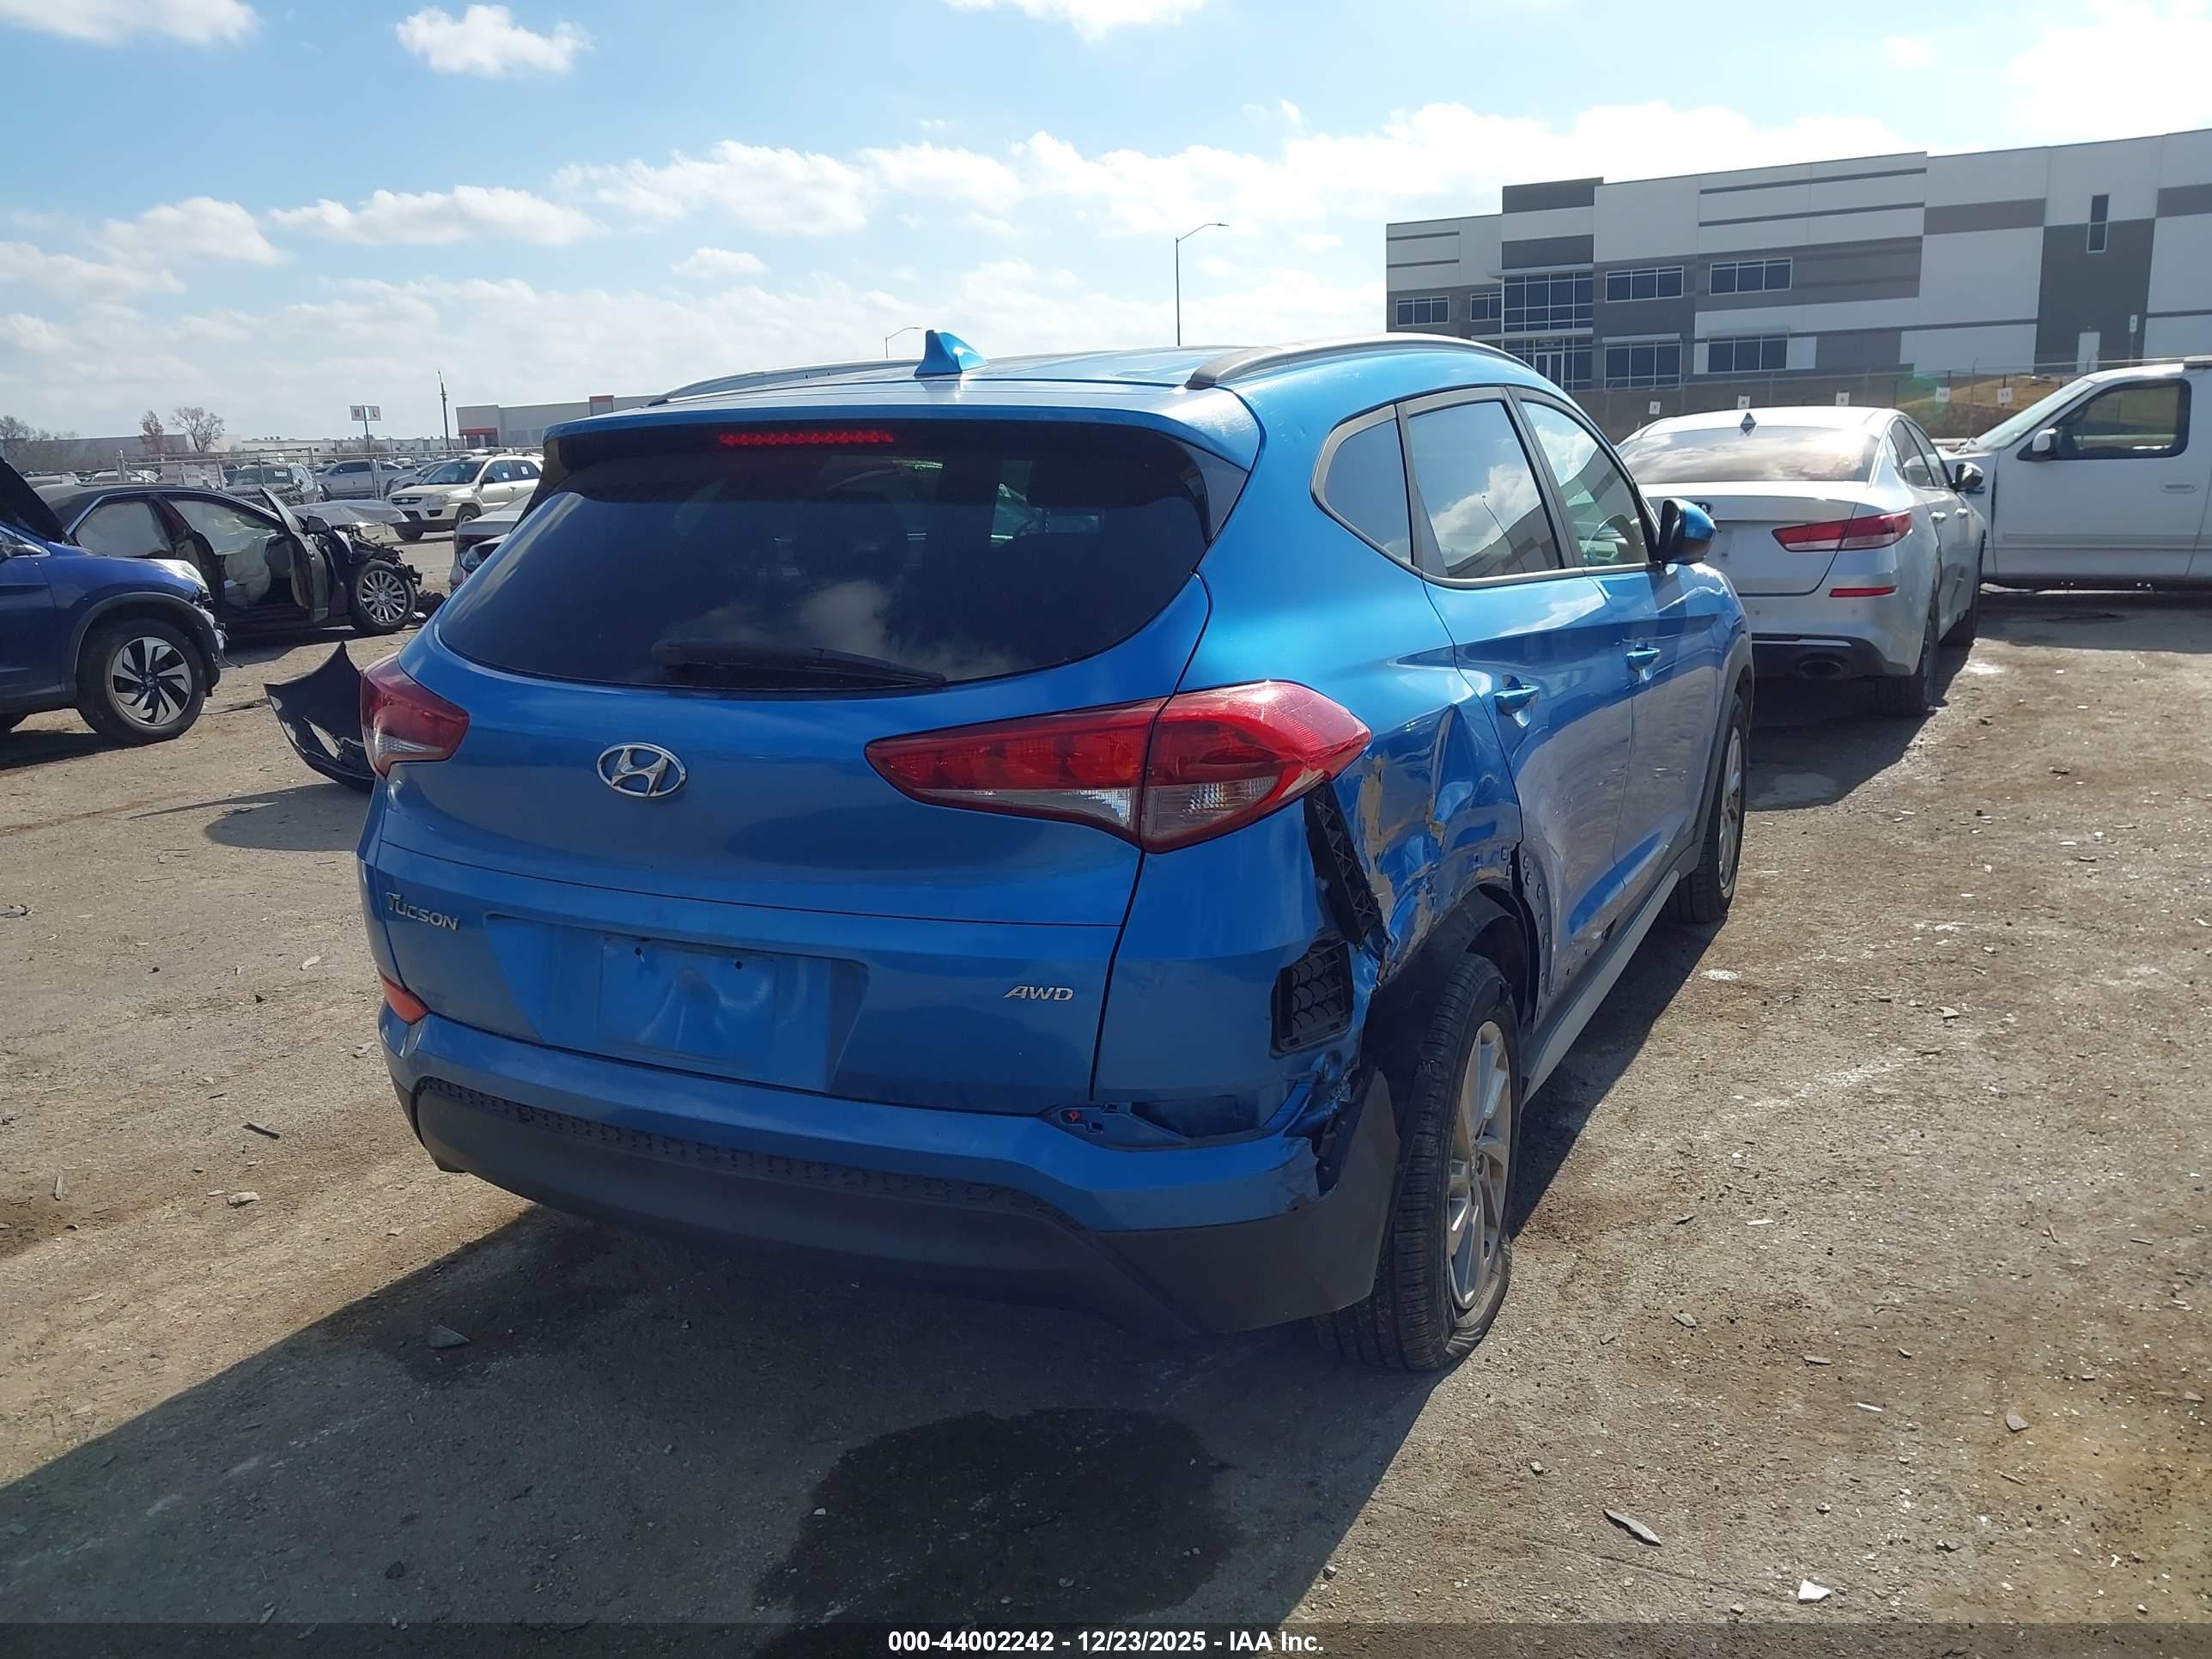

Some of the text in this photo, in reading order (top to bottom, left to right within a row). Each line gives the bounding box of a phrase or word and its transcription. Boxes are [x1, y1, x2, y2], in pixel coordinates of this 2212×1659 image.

[372, 409, 378, 417] L
[386, 891, 459, 931] TUCSON
[1003, 986, 1073, 1000] AWD
